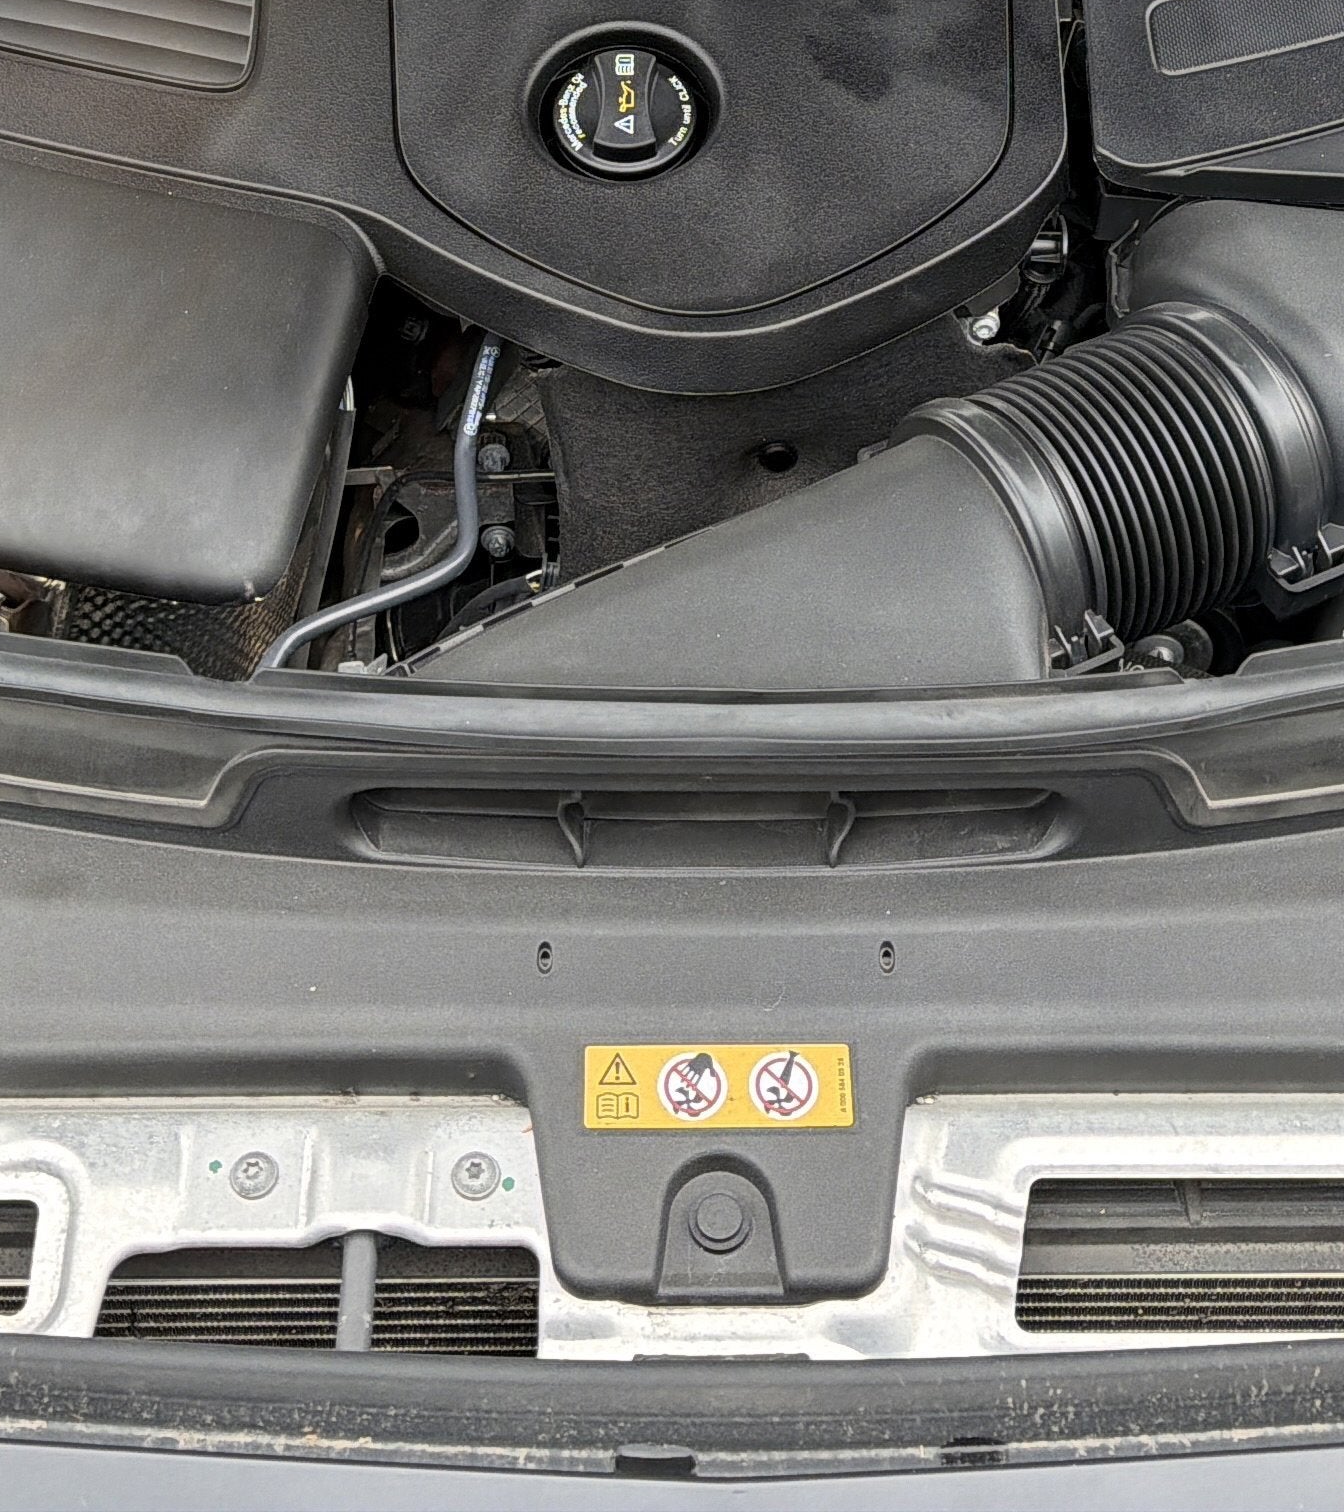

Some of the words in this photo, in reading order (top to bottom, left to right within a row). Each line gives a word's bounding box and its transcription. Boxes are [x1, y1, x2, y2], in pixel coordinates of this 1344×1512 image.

[668, 75, 689, 102] CLICK
[558, 84, 583, 151] Mercedes-Benz
[668, 126, 687, 146] Turn
